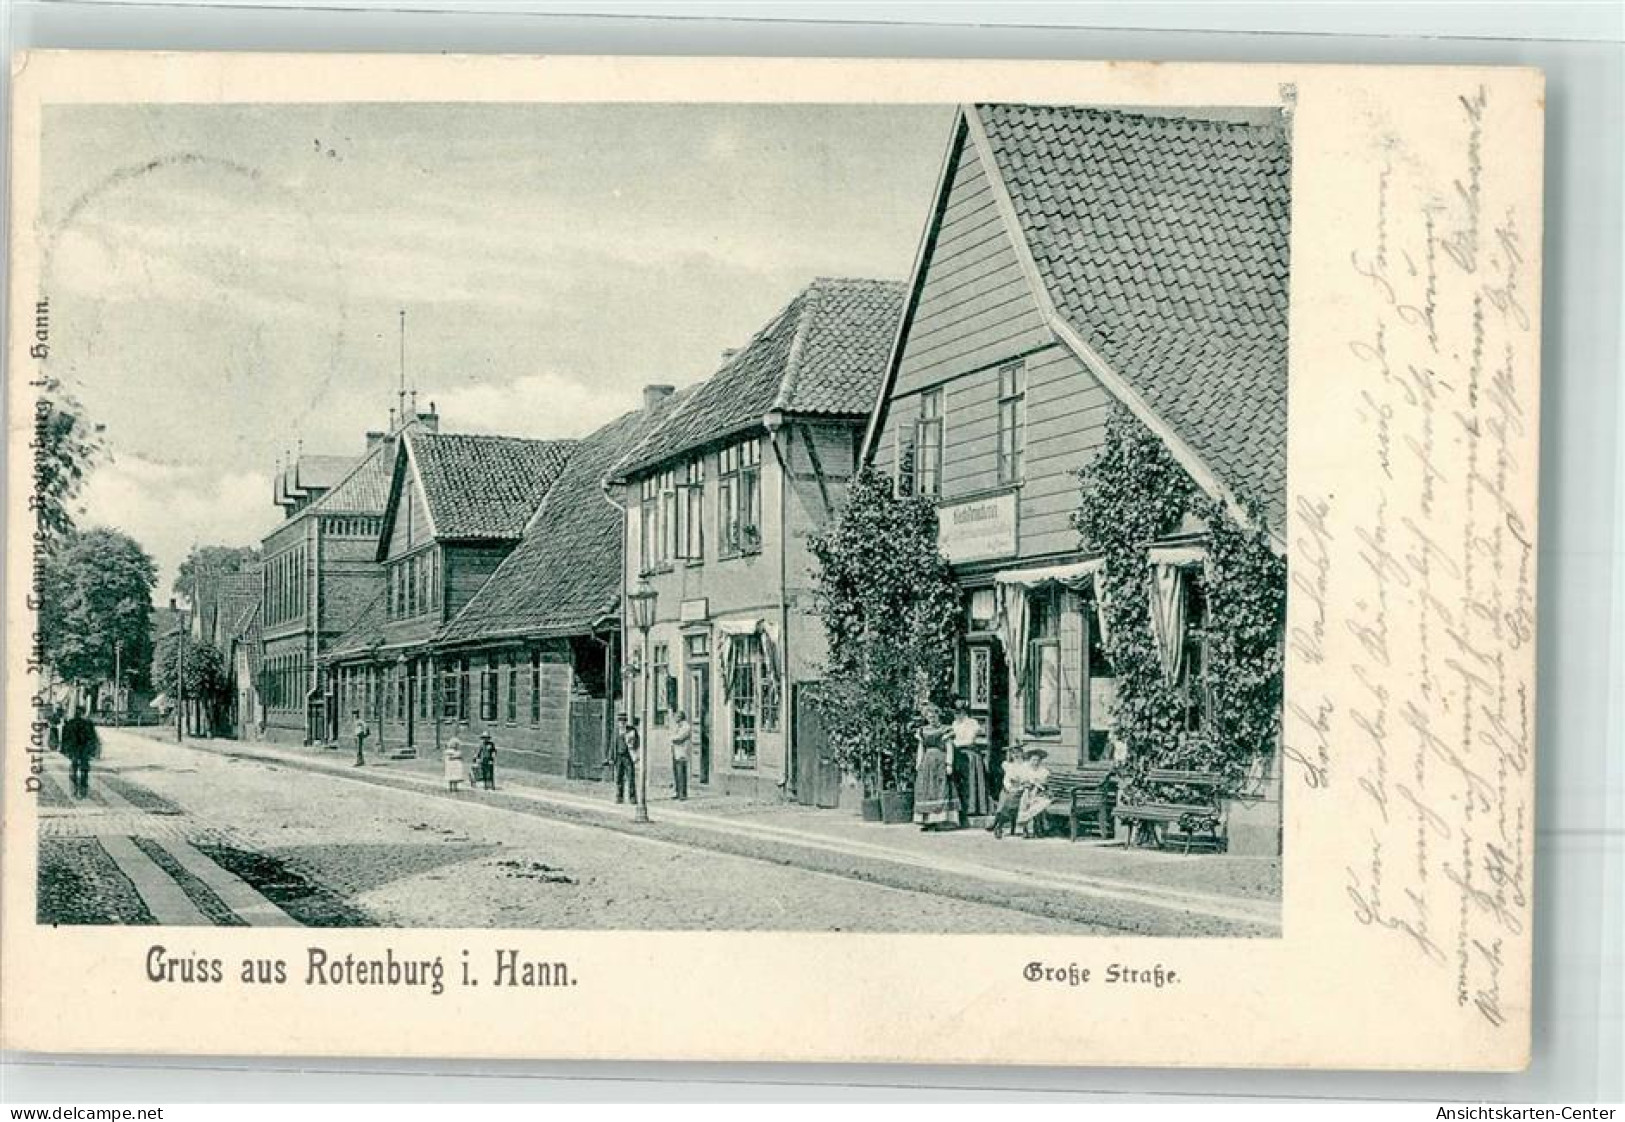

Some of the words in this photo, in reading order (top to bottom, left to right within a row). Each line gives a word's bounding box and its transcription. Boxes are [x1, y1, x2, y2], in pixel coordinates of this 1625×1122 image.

[30, 295, 49, 359] Hann.
[25, 720, 47, 792] Verlag
[146, 944, 223, 984] Gruss
[240, 958, 288, 985] aus
[305, 947, 445, 995] Rotenburg
[462, 949, 478, 986] i.
[493, 949, 578, 987] Hann.
[1022, 961, 1091, 987] Große
[1104, 963, 1181, 988] Straße.
